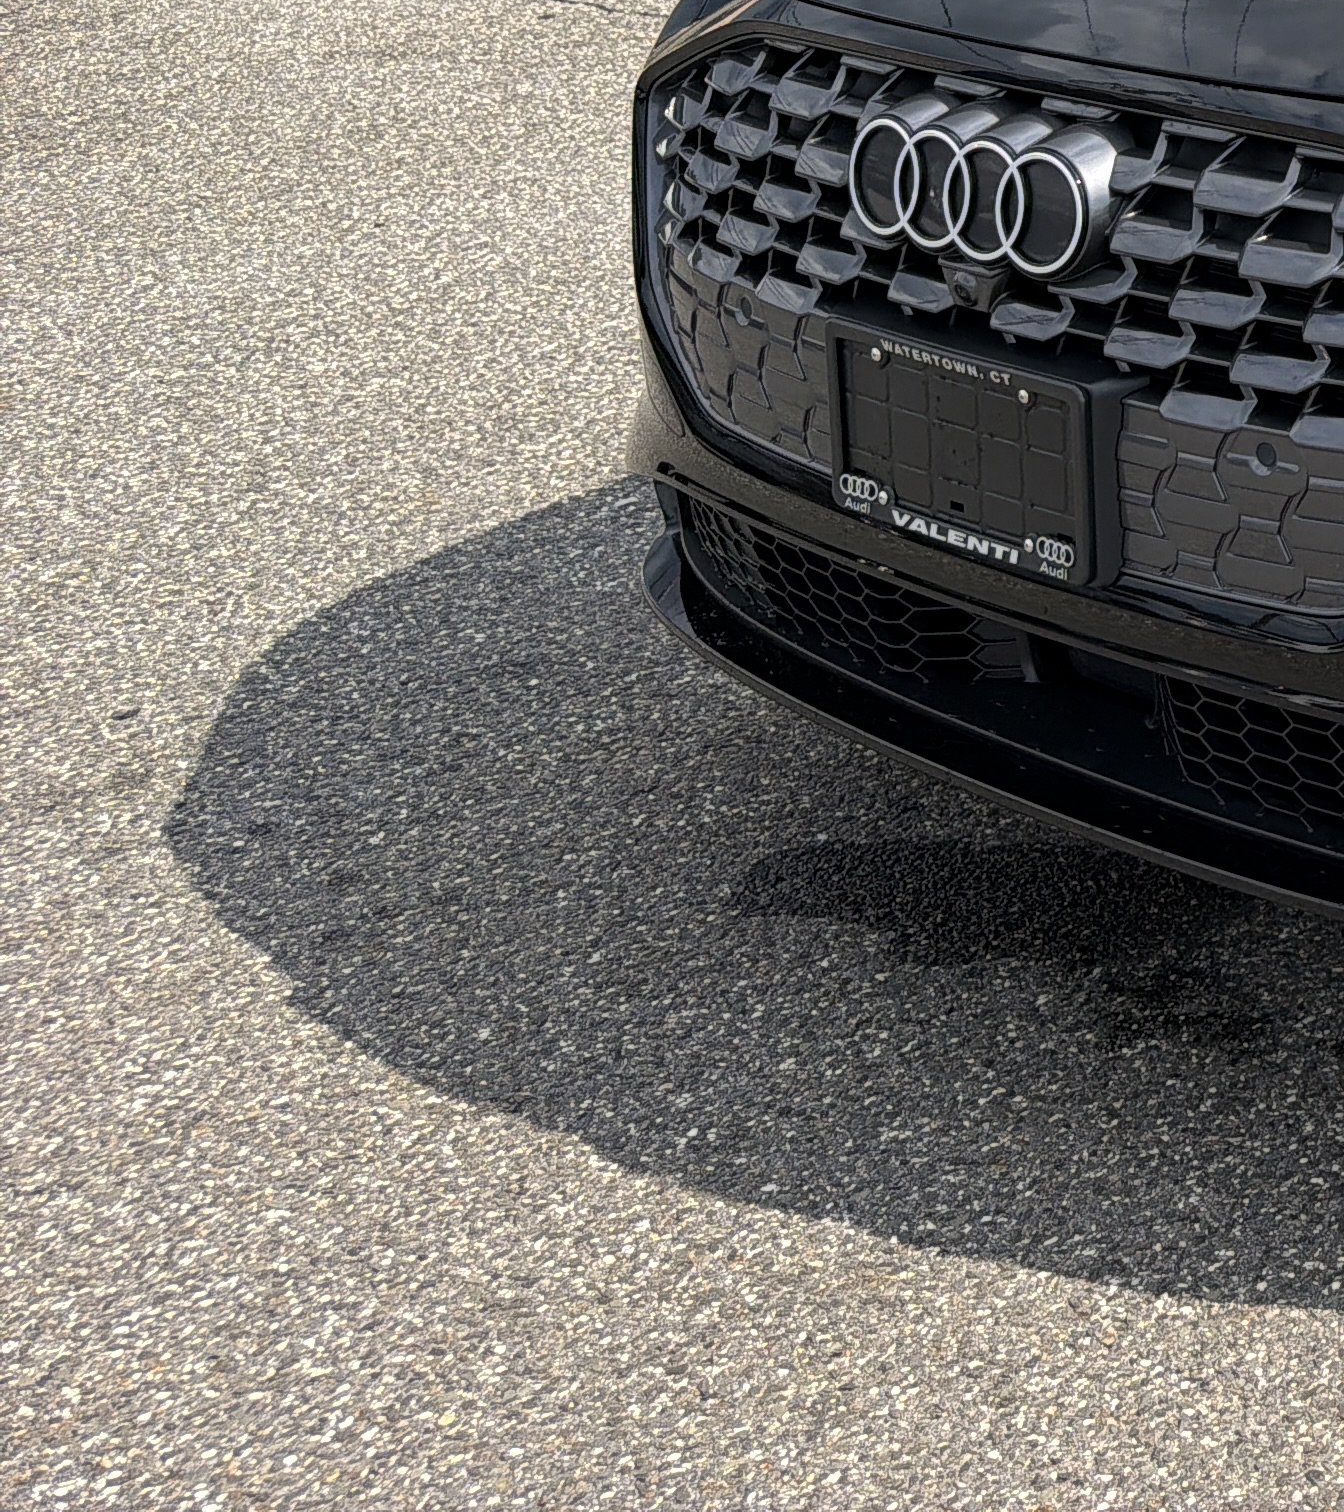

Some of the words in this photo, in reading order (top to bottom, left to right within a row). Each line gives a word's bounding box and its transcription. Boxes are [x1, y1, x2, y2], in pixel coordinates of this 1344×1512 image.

[880, 338, 985, 381] WATERTOWN,
[989, 370, 1012, 386] CT
[844, 497, 871, 515] Audi
[891, 509, 1020, 565] VALENTI
[1039, 560, 1069, 581] Audi
